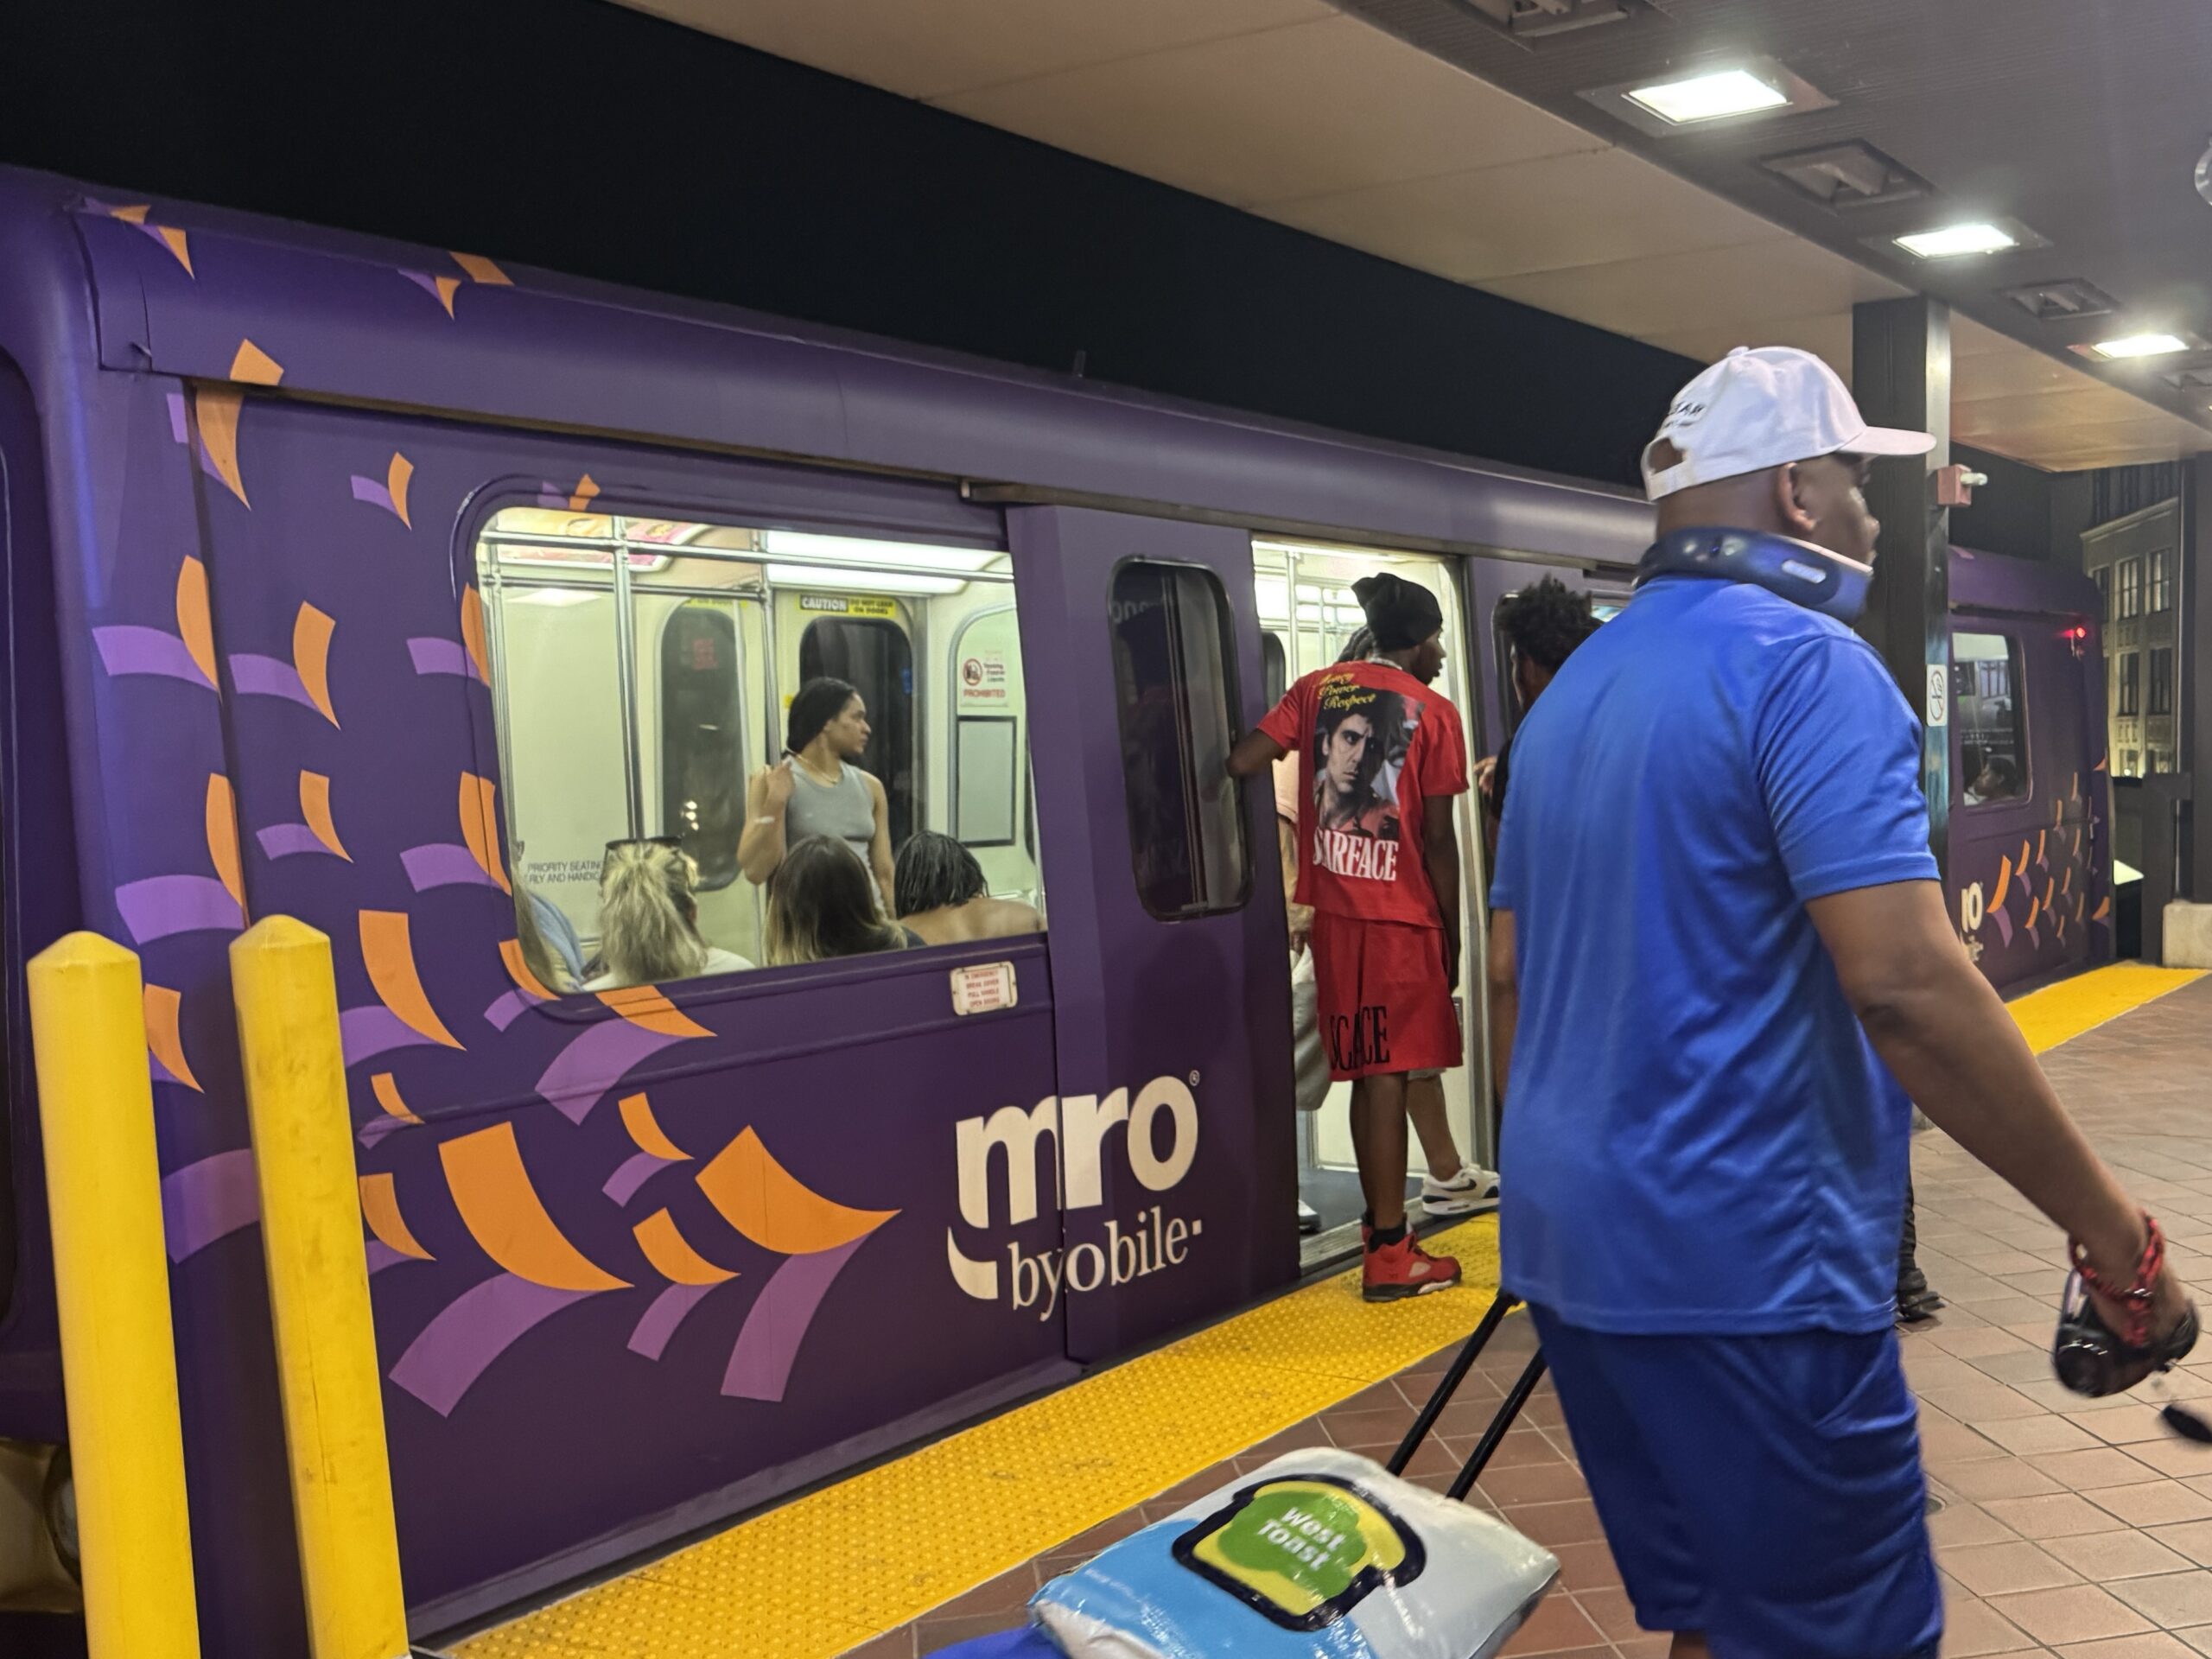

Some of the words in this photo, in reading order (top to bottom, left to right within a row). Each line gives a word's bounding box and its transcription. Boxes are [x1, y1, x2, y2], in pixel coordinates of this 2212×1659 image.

[801, 597, 847, 611] CAUTION
[527, 861, 567, 873] PRIORITY
[547, 873, 566, 882] AND
